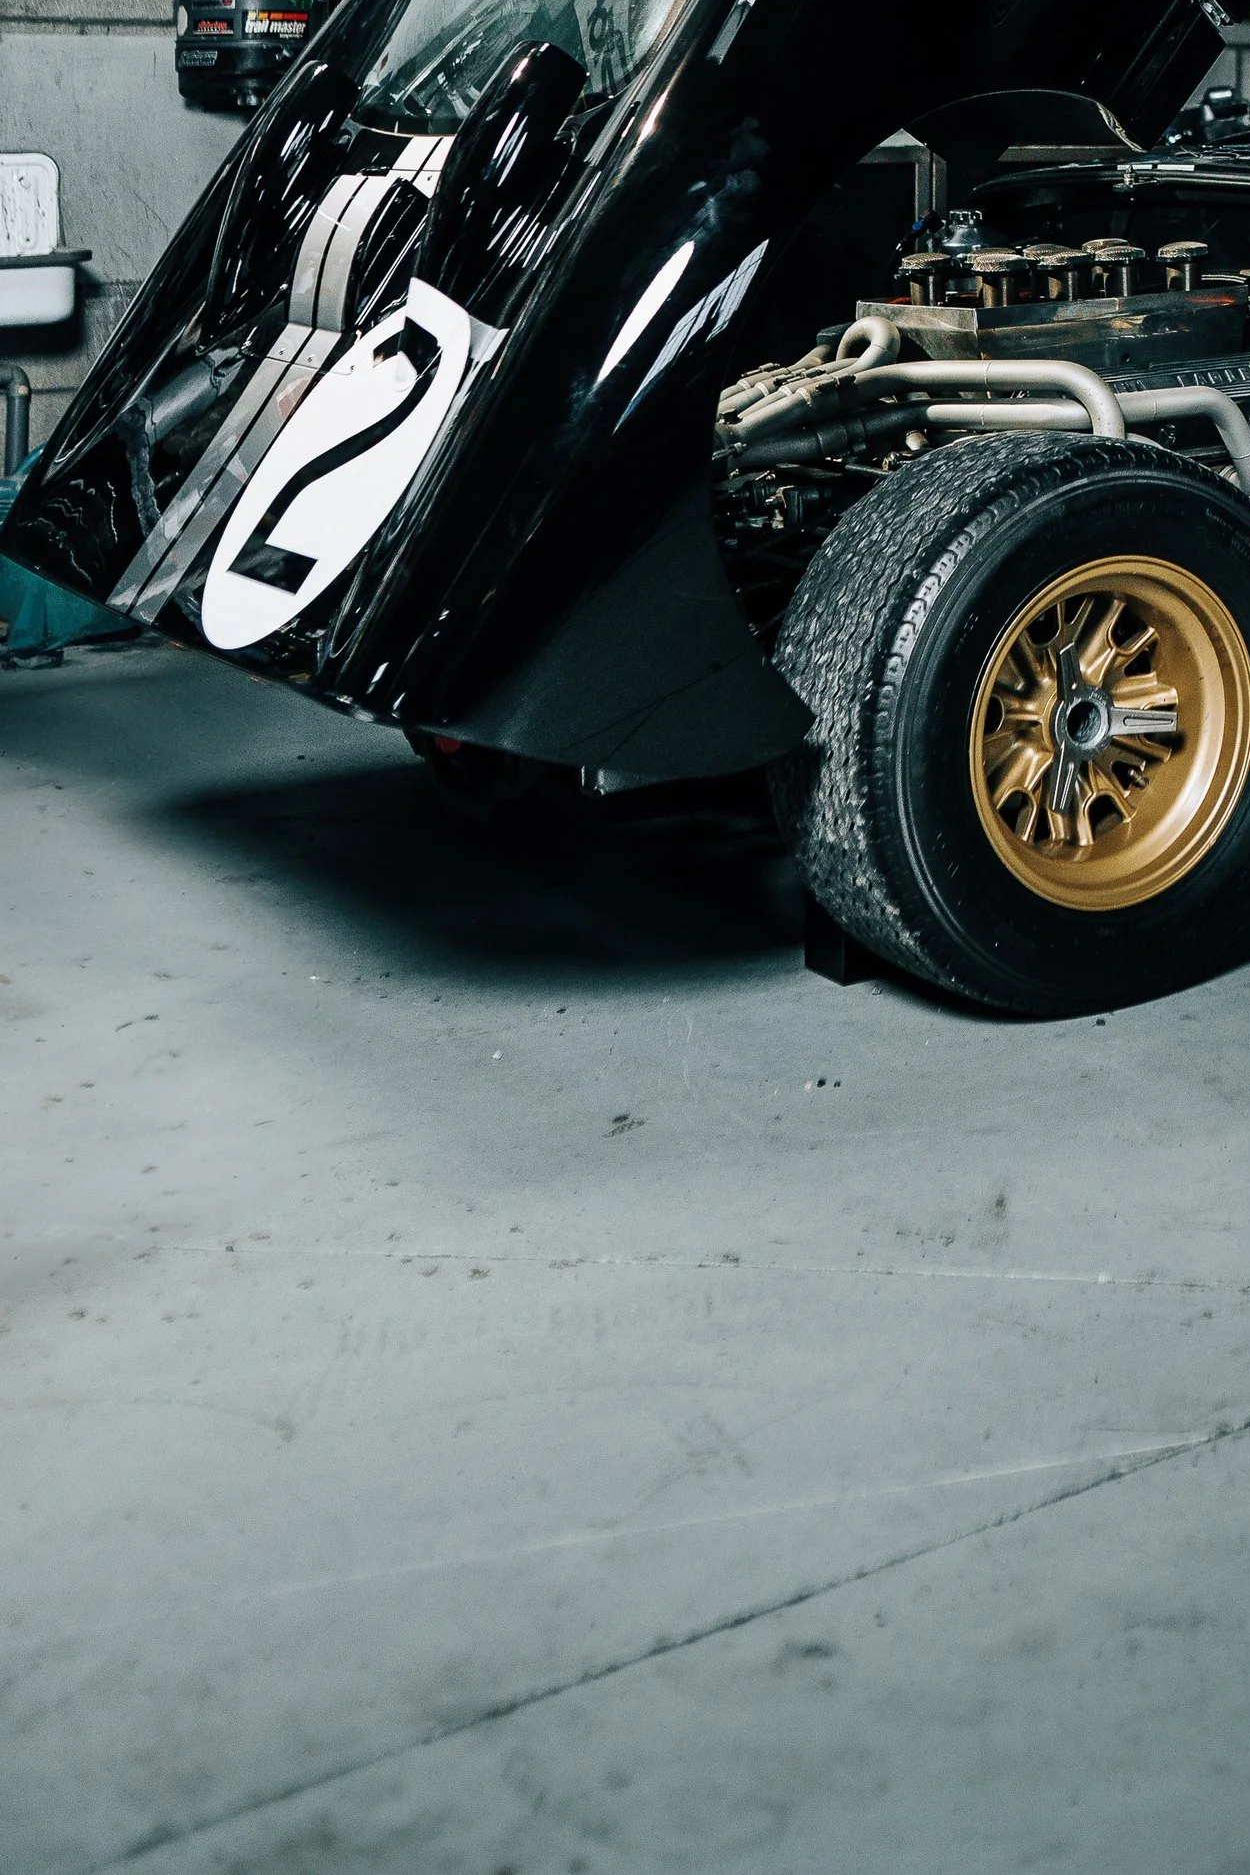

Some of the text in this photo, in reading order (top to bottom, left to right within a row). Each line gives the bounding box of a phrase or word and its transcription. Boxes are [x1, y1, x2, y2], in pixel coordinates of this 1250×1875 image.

[245, 18, 269, 33] trail
[269, 20, 306, 34] master
[226, 316, 444, 595] 2
